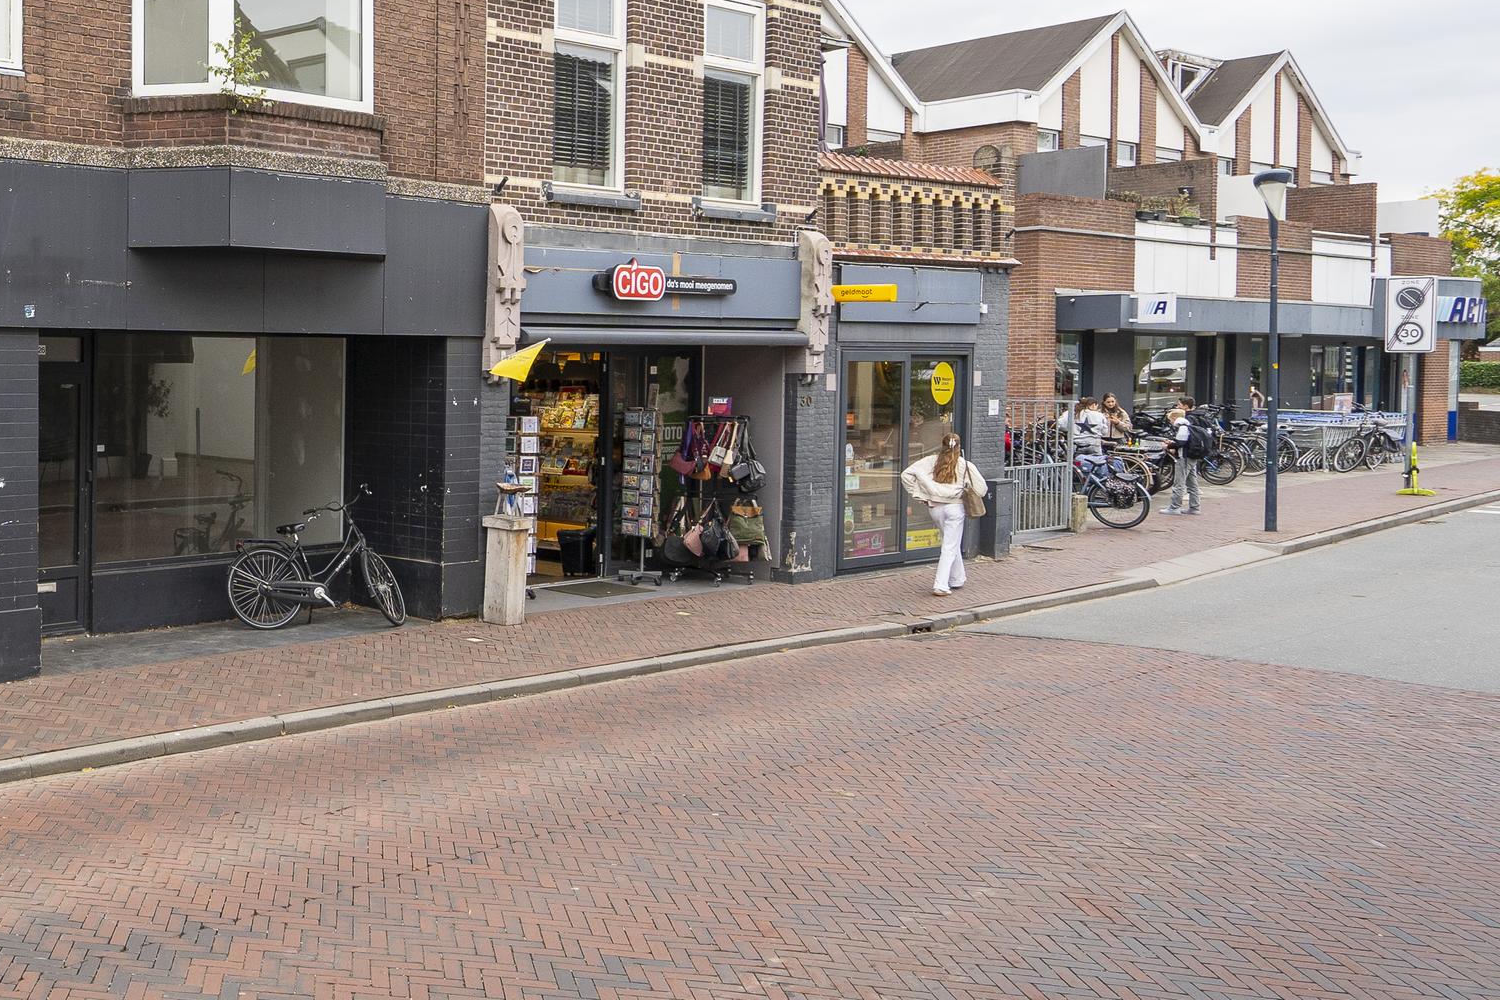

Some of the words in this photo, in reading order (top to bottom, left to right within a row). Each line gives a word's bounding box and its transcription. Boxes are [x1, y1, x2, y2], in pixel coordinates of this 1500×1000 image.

[680, 280, 695, 289] mooi
[695, 282, 733, 291] meegenomen
[1400, 328, 1419, 338] 30
